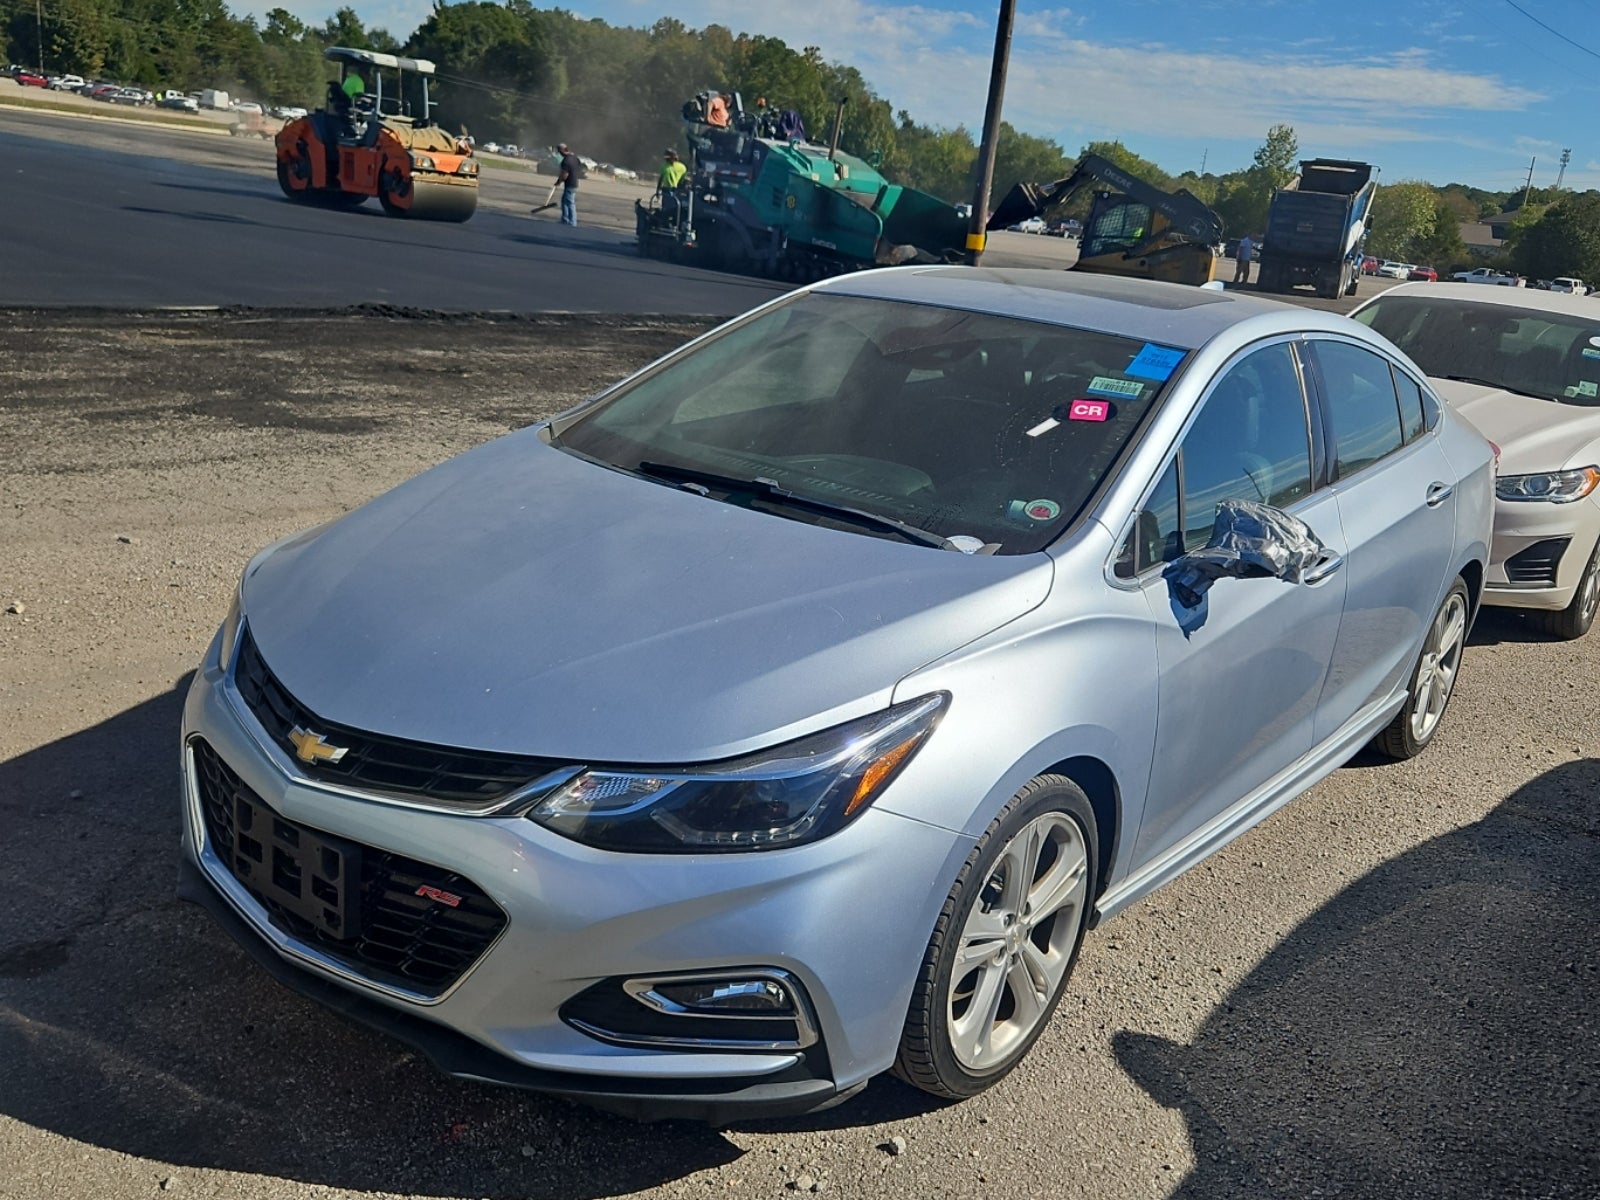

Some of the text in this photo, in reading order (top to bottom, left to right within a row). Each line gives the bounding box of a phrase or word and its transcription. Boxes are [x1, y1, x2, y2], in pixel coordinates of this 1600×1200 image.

[1104, 168, 1133, 190] DEERE
[1074, 404, 1103, 416] CR
[415, 884, 462, 908] RS
